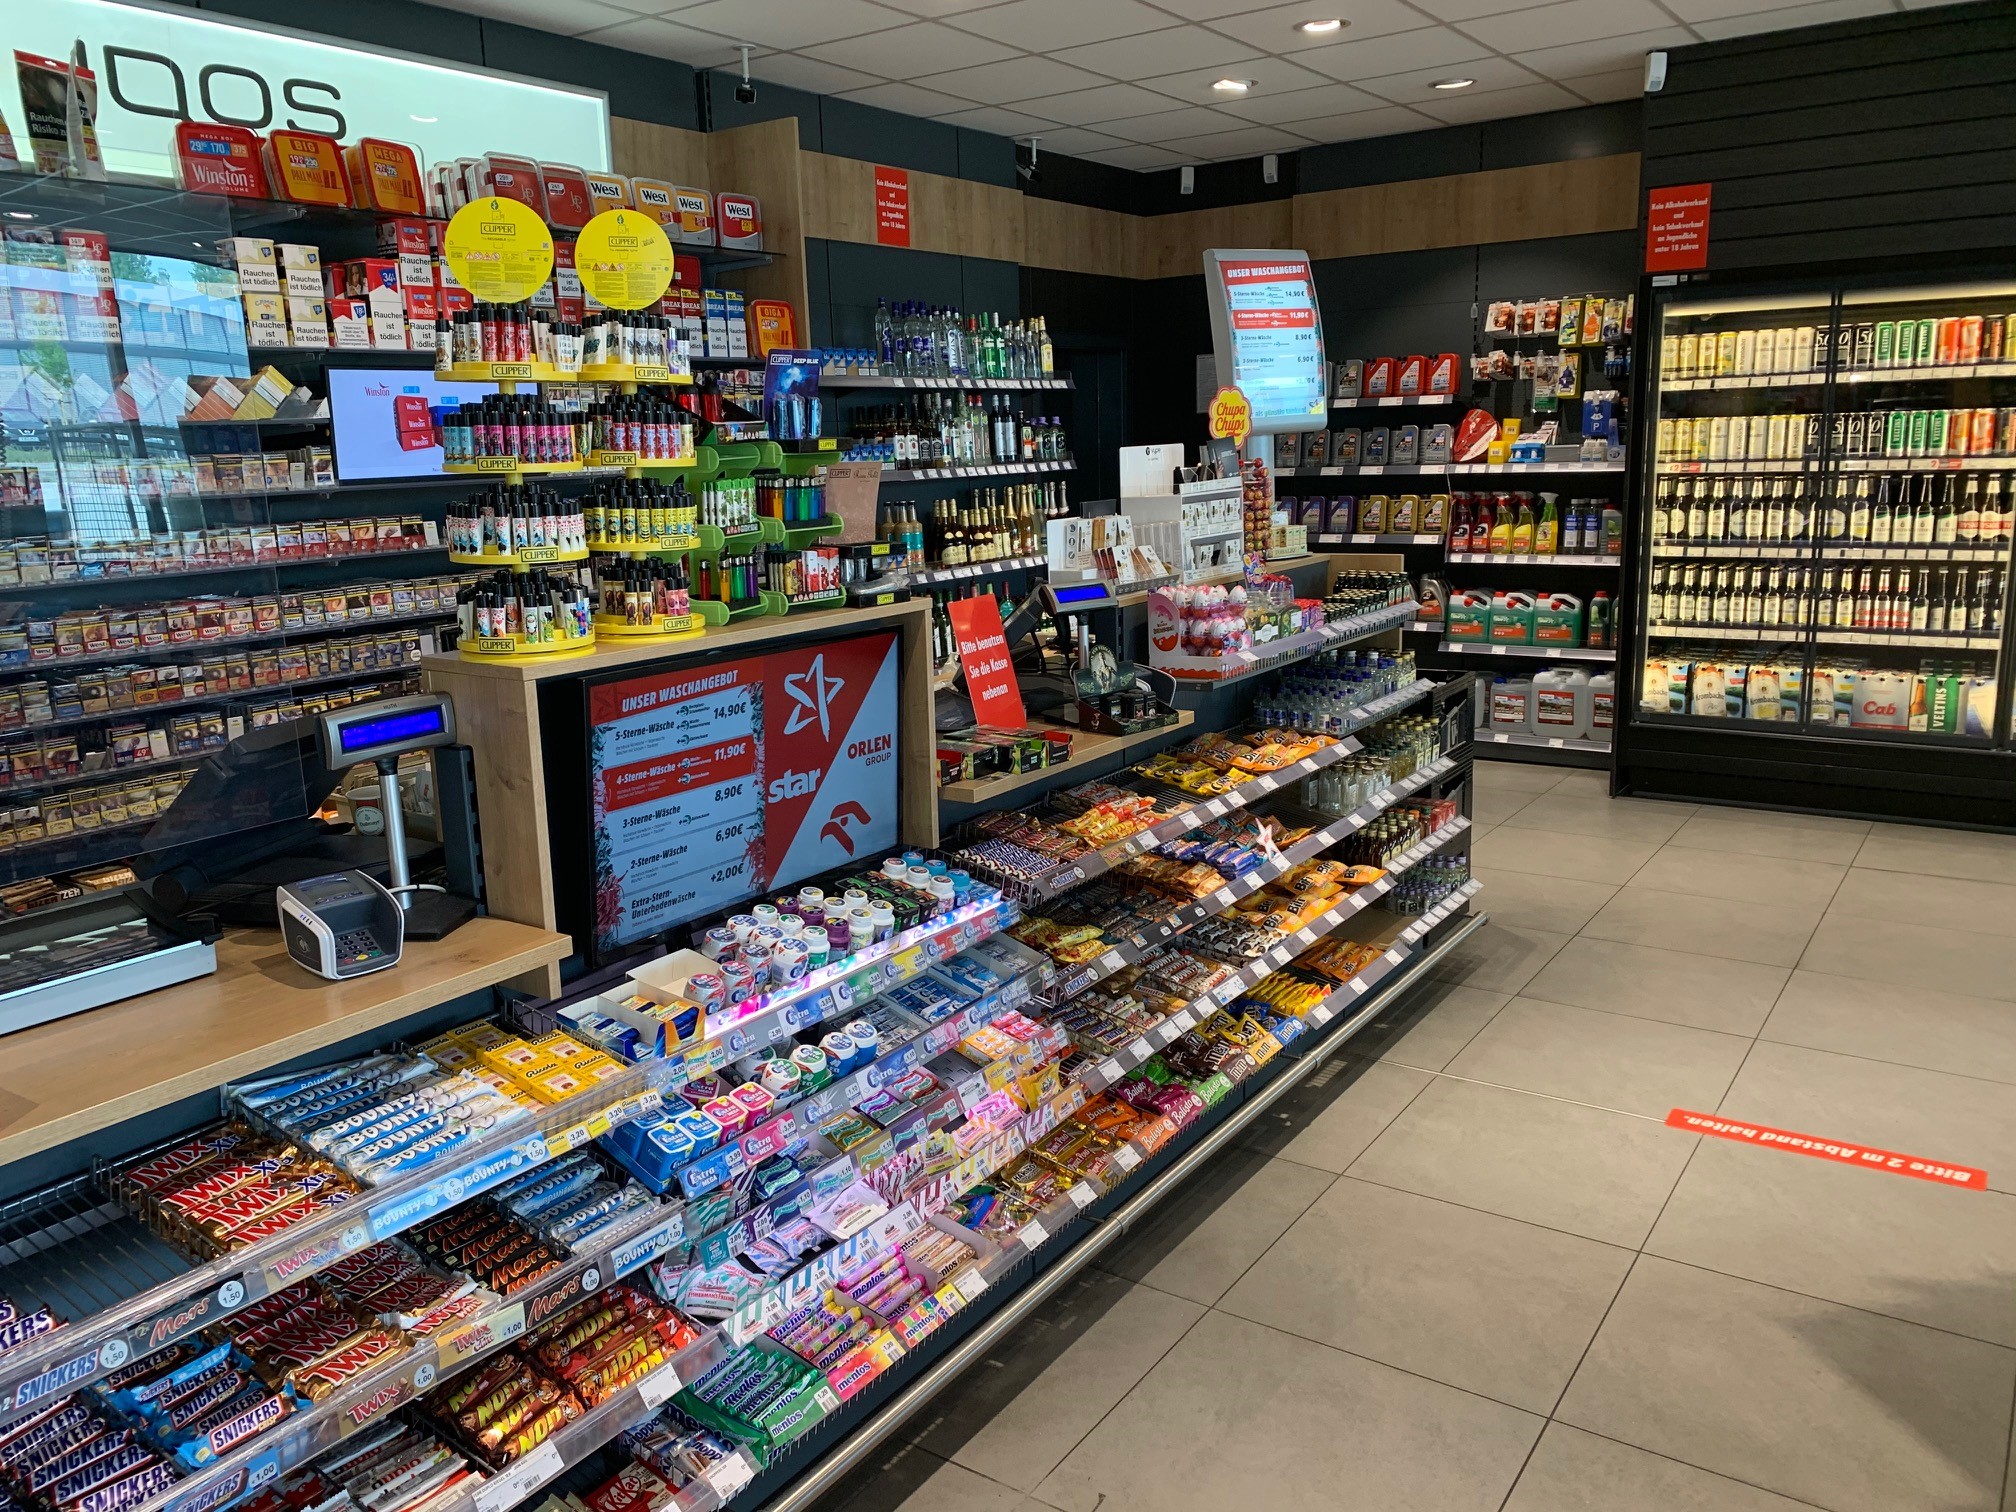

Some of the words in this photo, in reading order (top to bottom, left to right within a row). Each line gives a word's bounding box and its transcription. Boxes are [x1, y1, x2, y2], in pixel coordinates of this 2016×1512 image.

[32, 123, 58, 135] Risiko
[210, 142, 225, 154] 170
[294, 140, 315, 152] BIG
[375, 149, 402, 162] MEGA
[191, 162, 248, 187] Winston
[590, 182, 620, 198] West
[642, 189, 669, 204] West
[679, 197, 704, 211] West
[727, 203, 751, 217] West
[1665, 198, 1708, 209] Alkoholverkauf
[1673, 211, 1685, 219] und
[483, 225, 512, 234] CLIPPER
[1666, 220, 1704, 230] Tabakverkauf
[610, 238, 636, 246] CLIPPER
[1666, 231, 1698, 242] Jugendliche
[1680, 243, 1699, 251] Jahren
[243, 269, 275, 278] Rauchen
[290, 275, 320, 283] Rauchen
[1227, 268, 1251, 278] UNSER
[1251, 264, 1305, 277] WASCHANGEBOT
[406, 276, 431, 284] tödlich
[255, 299, 278, 307] CAMEL
[252, 321, 286, 329] Rauchen
[258, 339, 285, 347] tödlich
[380, 333, 403, 341] tödlich
[1881, 328, 1889, 353] VELTINS
[1901, 327, 1910, 352] VELTINS
[1920, 325, 1928, 350] VELTINS
[772, 356, 792, 364] CLIPPER
[495, 365, 530, 378] CLIPPER
[637, 367, 667, 379] CLIPPER
[364, 386, 390, 397] Winston
[1216, 402, 1246, 421] Chupa
[1215, 417, 1245, 432] Chups
[479, 457, 515, 470] CLIPPER
[602, 453, 636, 465] CLIPPER
[663, 537, 689, 548] CLIPPER
[524, 548, 558, 561] CLIPPER
[666, 618, 691, 630] CLIPPER
[481, 639, 514, 651] CLIPPER
[960, 640, 977, 655] Bitte
[976, 634, 1004, 651] benutzen
[969, 664, 980, 679] Sie
[980, 661, 991, 675] die
[990, 658, 1008, 672] Kasse
[621, 688, 656, 713] UNSER
[658, 669, 739, 707] WASCHANGEBOT
[1863, 701, 1897, 718] Cab
[1933, 686, 1947, 731] VELTINS
[614, 720, 675, 742] 5-Sterne-Wäsche
[713, 702, 747, 720] 14,90€
[847, 734, 892, 759] ORLEN
[616, 763, 676, 785] 4-Sterne-Wäsche
[714, 743, 746, 761] 11,90€
[865, 752, 892, 767] GROUP
[768, 768, 821, 803] star
[622, 805, 681, 829] 3-Sterne-Wäsche
[714, 784, 743, 802] 8,90€
[630, 844, 688, 870] 2-Sterne-Wäsche
[715, 823, 744, 842] 6,90€
[631, 889, 673, 910] Extra-Stern-
[710, 862, 745, 883] +2,00€
[631, 890, 696, 920] Unterbodenwäsche
[454, 1020, 487, 1036] Ricola
[485, 1037, 517, 1053] Ricola
[530, 1031, 561, 1046] Ricola
[525, 1062, 557, 1078] Ricola
[574, 1054, 606, 1069] Ricola
[1200, 1080, 1220, 1102] Balisto
[332, 1093, 416, 1133] BOUNTY
[1172, 1099, 1193, 1124] Balisto
[348, 1102, 434, 1146] BOUNTY
[1685, 1114, 1757, 1138] halten.
[364, 1112, 446, 1157] BOUNTY
[547, 1134, 564, 1146] Ricola
[1141, 1123, 1165, 1149] Balisto
[385, 1124, 469, 1168] BOUNTY
[1760, 1130, 1860, 1159] Abstand
[1861, 1151, 1886, 1163] m
[1887, 1156, 1906, 1168] 2
[463, 1158, 508, 1187] BOUNTY
[690, 1166, 715, 1185] Extra
[1013, 1162, 1037, 1182] HARIBO
[1909, 1161, 1972, 1183] Bitte
[168, 1163, 257, 1213] TWIX
[702, 1175, 718, 1187] MEGA
[270, 1246, 320, 1279] Twix
[614, 1240, 657, 1268] BOUNTY
[492, 1247, 548, 1291] Mars
[584, 1277, 598, 1289] 1,00
[851, 1269, 886, 1299] mentos
[527, 1275, 580, 1328] Mars
[149, 1297, 211, 1348] Mars
[905, 1312, 935, 1340] mentos
[103, 1350, 125, 1366] 1,50
[302, 1332, 398, 1386] TWIX
[603, 1335, 648, 1384] LION
[18, 1350, 99, 1407] SNICKERS
[838, 1361, 871, 1392] mentos
[347, 1382, 401, 1424] Twix
[213, 1398, 280, 1449] SNICKERS
[771, 1410, 803, 1437] mentos
[602, 1474, 641, 1511] KitKat
